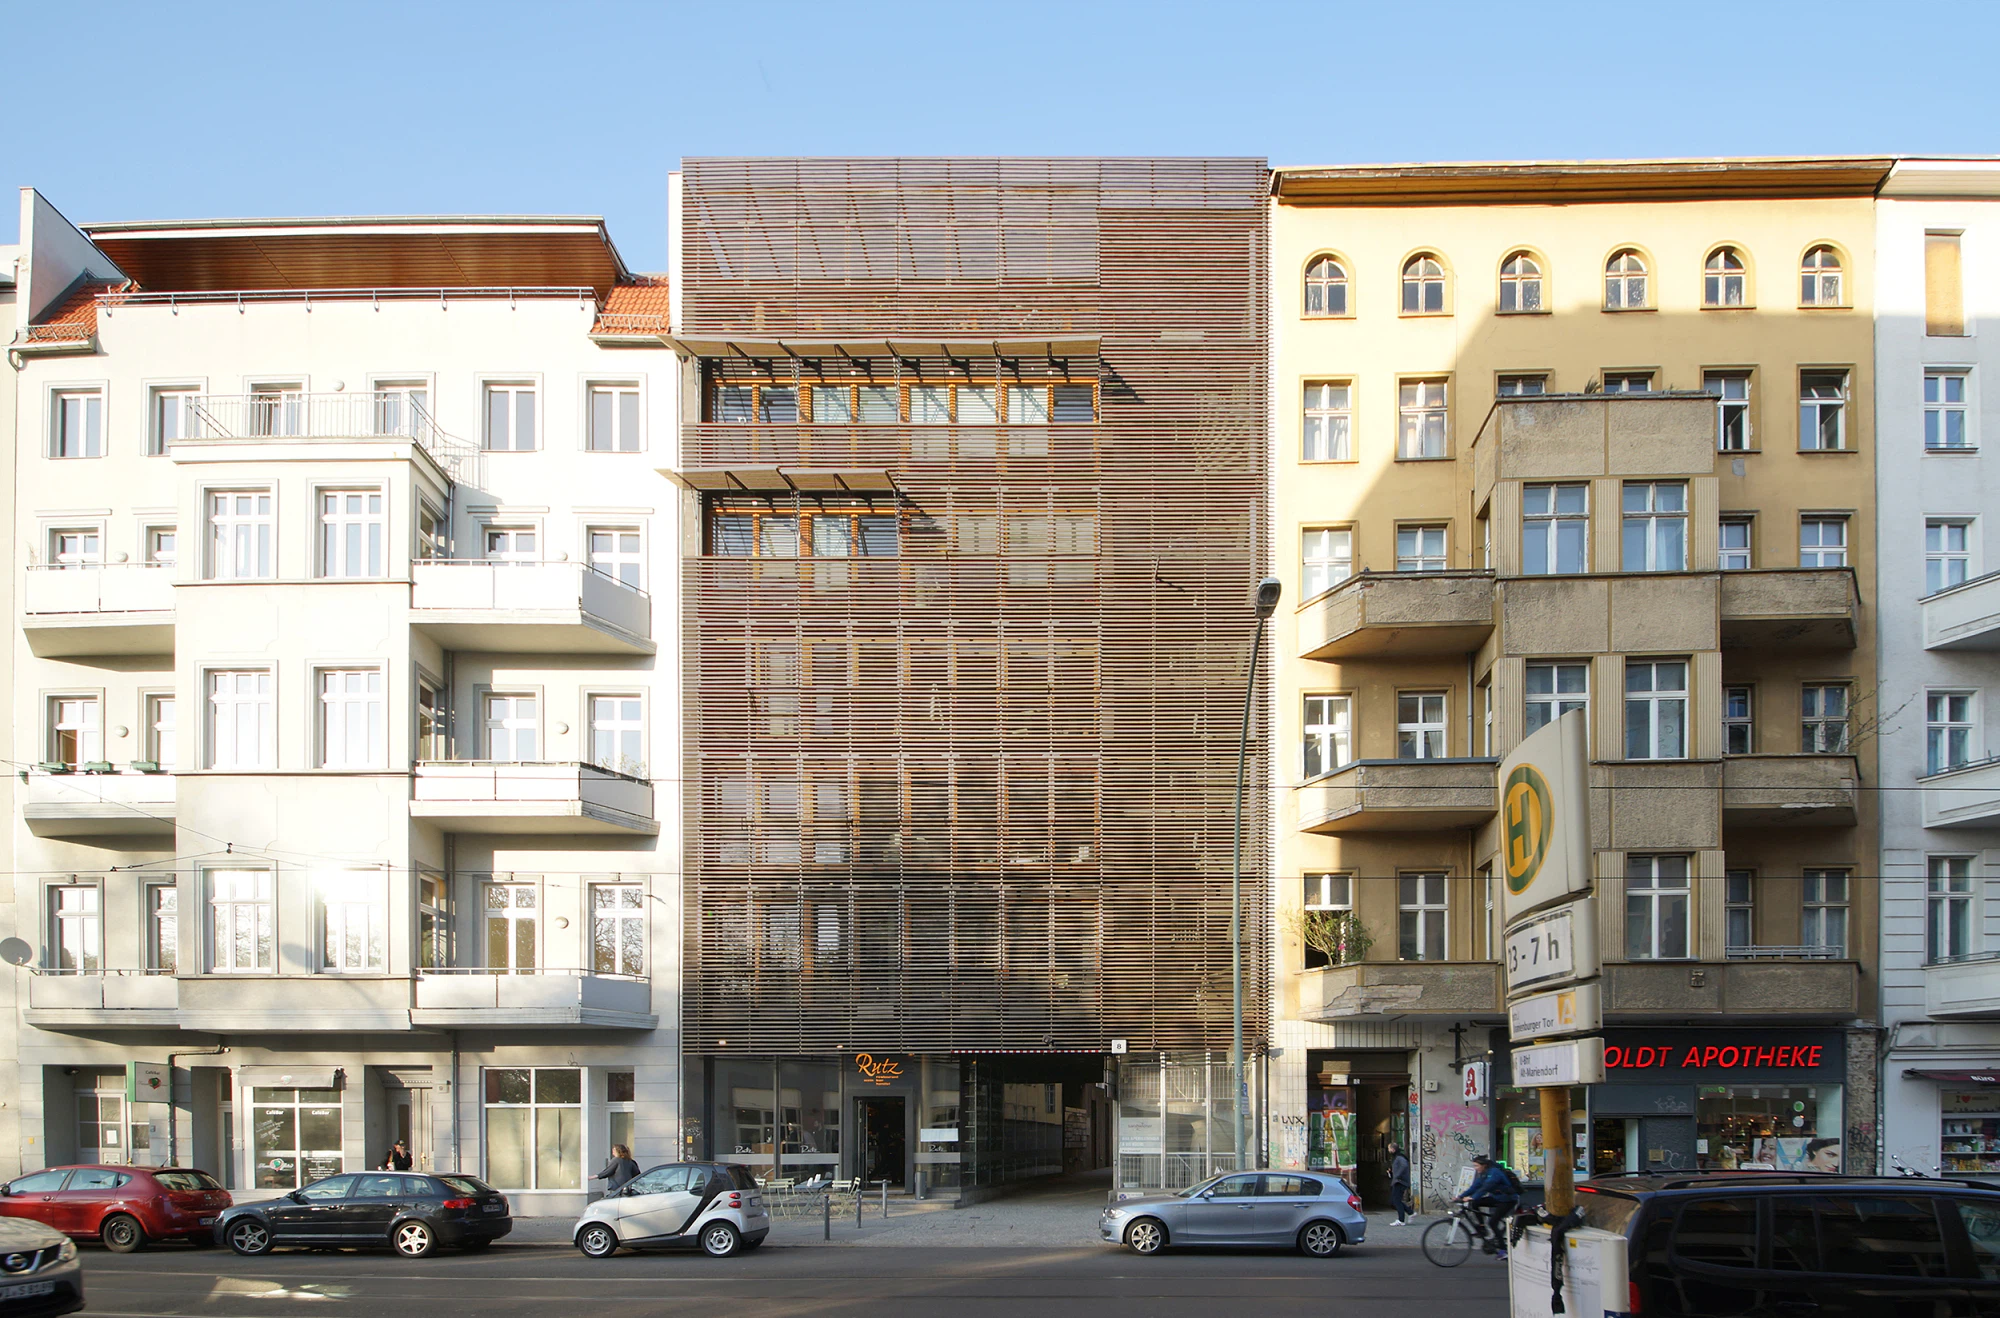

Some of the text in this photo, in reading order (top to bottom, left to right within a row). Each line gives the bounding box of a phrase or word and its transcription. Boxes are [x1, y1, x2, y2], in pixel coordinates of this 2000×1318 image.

[1507, 790, 1532, 869] H
[1531, 936, 1540, 965] 7
[1548, 932, 1560, 961] h
[1542, 1017, 1555, 1028] Tor
[855, 1053, 904, 1077] Rutz
[1603, 1045, 1823, 1068] OLDT APOTHEKE
[1520, 1064, 1558, 1078] Alt-Mariendorf
